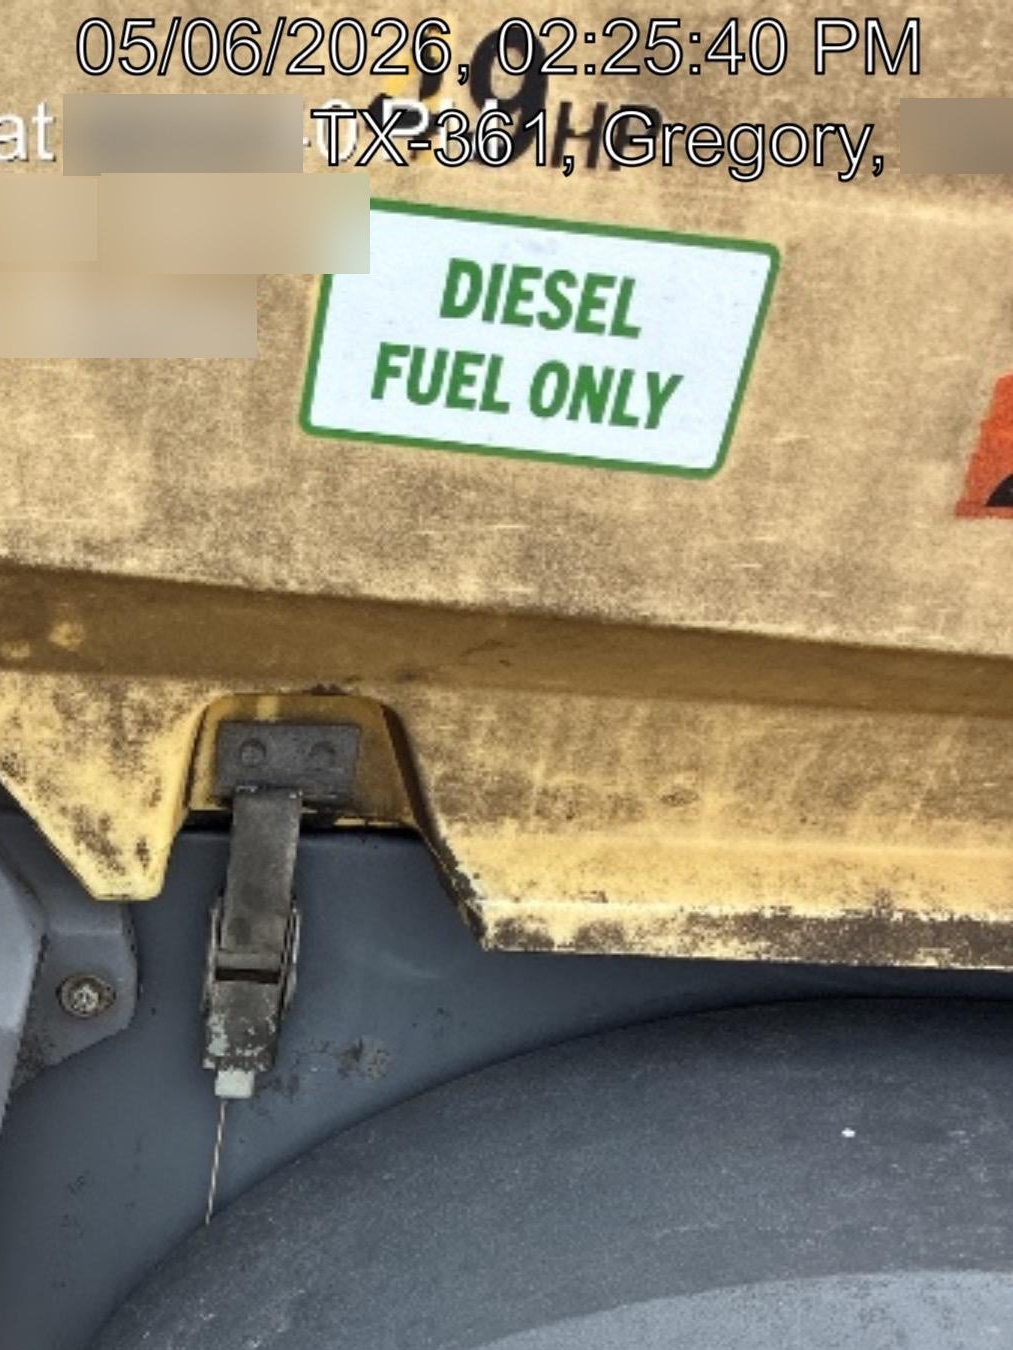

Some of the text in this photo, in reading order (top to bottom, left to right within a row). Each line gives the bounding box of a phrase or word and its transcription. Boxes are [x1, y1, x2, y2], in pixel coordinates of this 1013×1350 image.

[439, 257, 643, 340] DIESEL
[370, 341, 685, 431] FUEL ONLY
